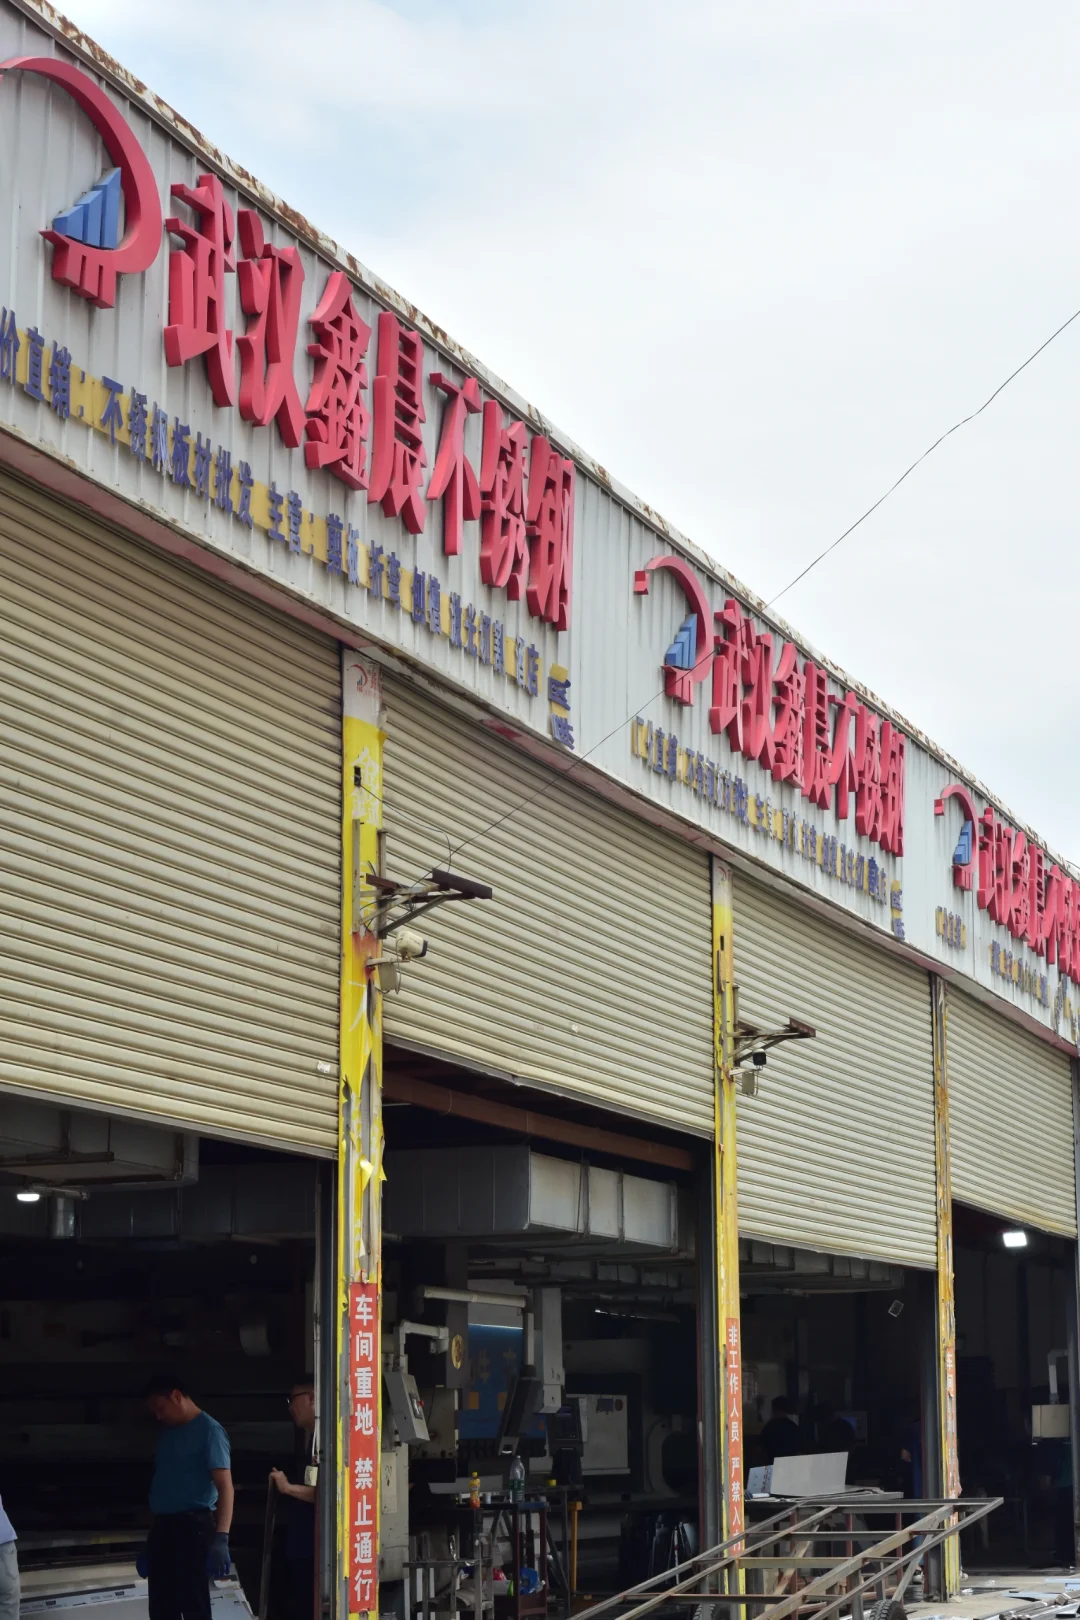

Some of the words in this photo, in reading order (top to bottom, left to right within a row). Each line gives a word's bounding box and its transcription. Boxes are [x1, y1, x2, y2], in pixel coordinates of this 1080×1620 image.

[164, 173, 575, 632] 武汉鑫晨不锈钢
[710, 598, 906, 857] 武汉鑫晨不锈钢
[354, 1294, 374, 1437] 车间重地
[728, 1325, 740, 1443] 非工作人员
[354, 1457, 374, 1602] 禁止通行
